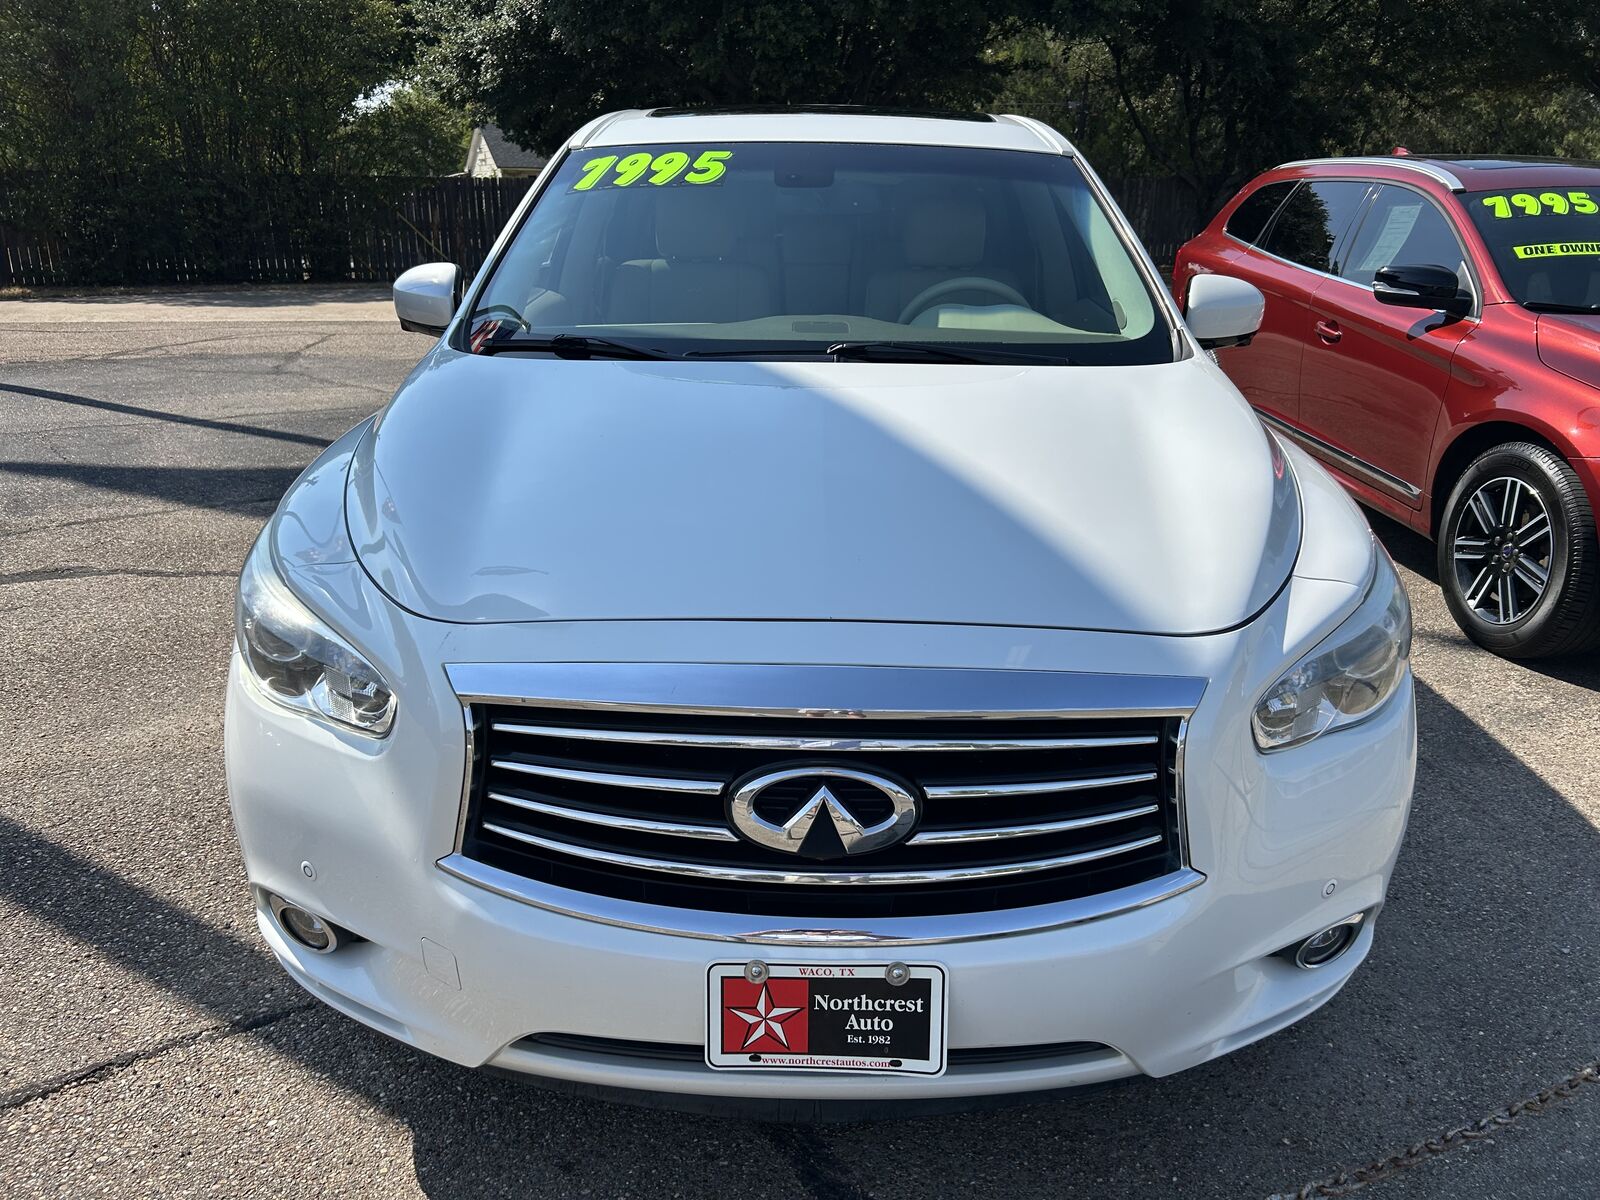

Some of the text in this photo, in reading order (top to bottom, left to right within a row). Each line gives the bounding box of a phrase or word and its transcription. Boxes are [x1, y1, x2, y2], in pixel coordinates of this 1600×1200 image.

[1523, 245, 1555, 256] ONE
[799, 967, 855, 977] WACO, TX
[813, 994, 924, 1013] Northcrest
[845, 1014, 894, 1032] Auto
[847, 1034, 891, 1045] Est. 1982
[762, 1056, 891, 1069] www.northcrestautos.com
